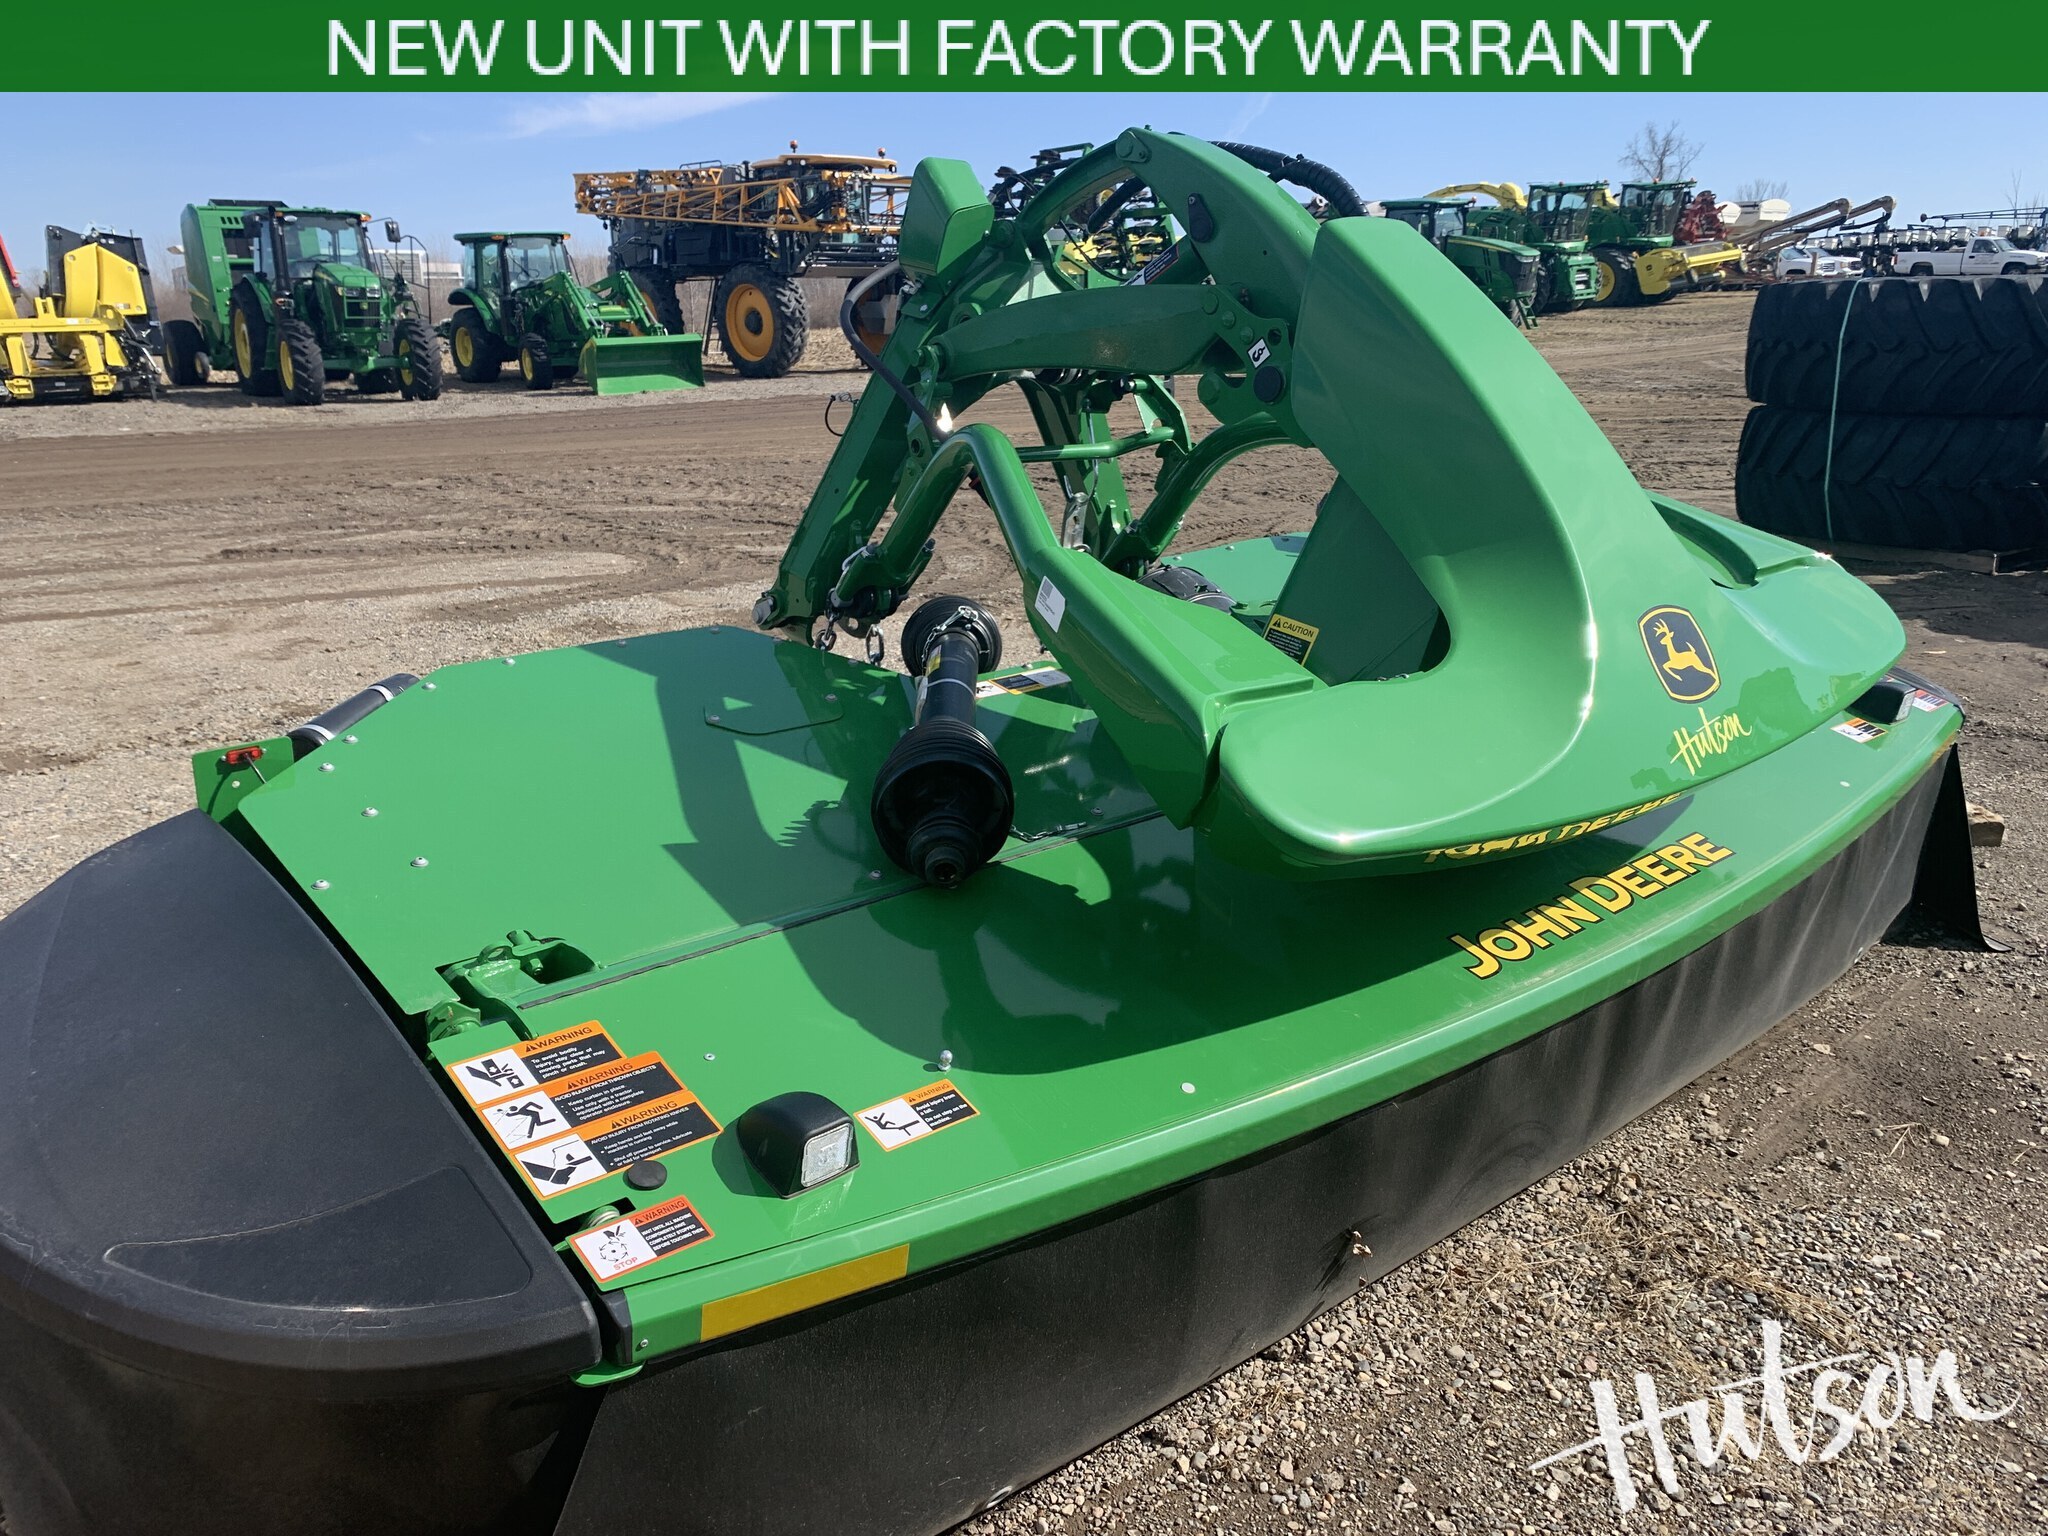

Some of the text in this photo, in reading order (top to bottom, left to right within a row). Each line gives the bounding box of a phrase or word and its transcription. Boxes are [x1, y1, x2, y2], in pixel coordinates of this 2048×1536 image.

[1282, 622, 1314, 637] CAUTION
[1670, 706, 1752, 776] Hutson
[1446, 831, 1736, 979] JOHN DEERE
[535, 1027, 593, 1049] WARNING
[559, 1047, 577, 1055] bodily
[539, 1065, 561, 1073] moving
[562, 1059, 577, 1067] parts
[577, 1063, 633, 1084] WARNING
[555, 1064, 656, 1101] AVOID INJURY FROM THROWN OBJECTS
[576, 1105, 602, 1116] equipped
[620, 1090, 644, 1101] complete
[585, 1100, 597, 1108] only
[620, 1101, 677, 1125] WARNING
[591, 1106, 689, 1144] AVOID INJURY FROM ROTATING KNIVES
[642, 1201, 684, 1220] WARNING
[613, 1257, 638, 1271] STOP
